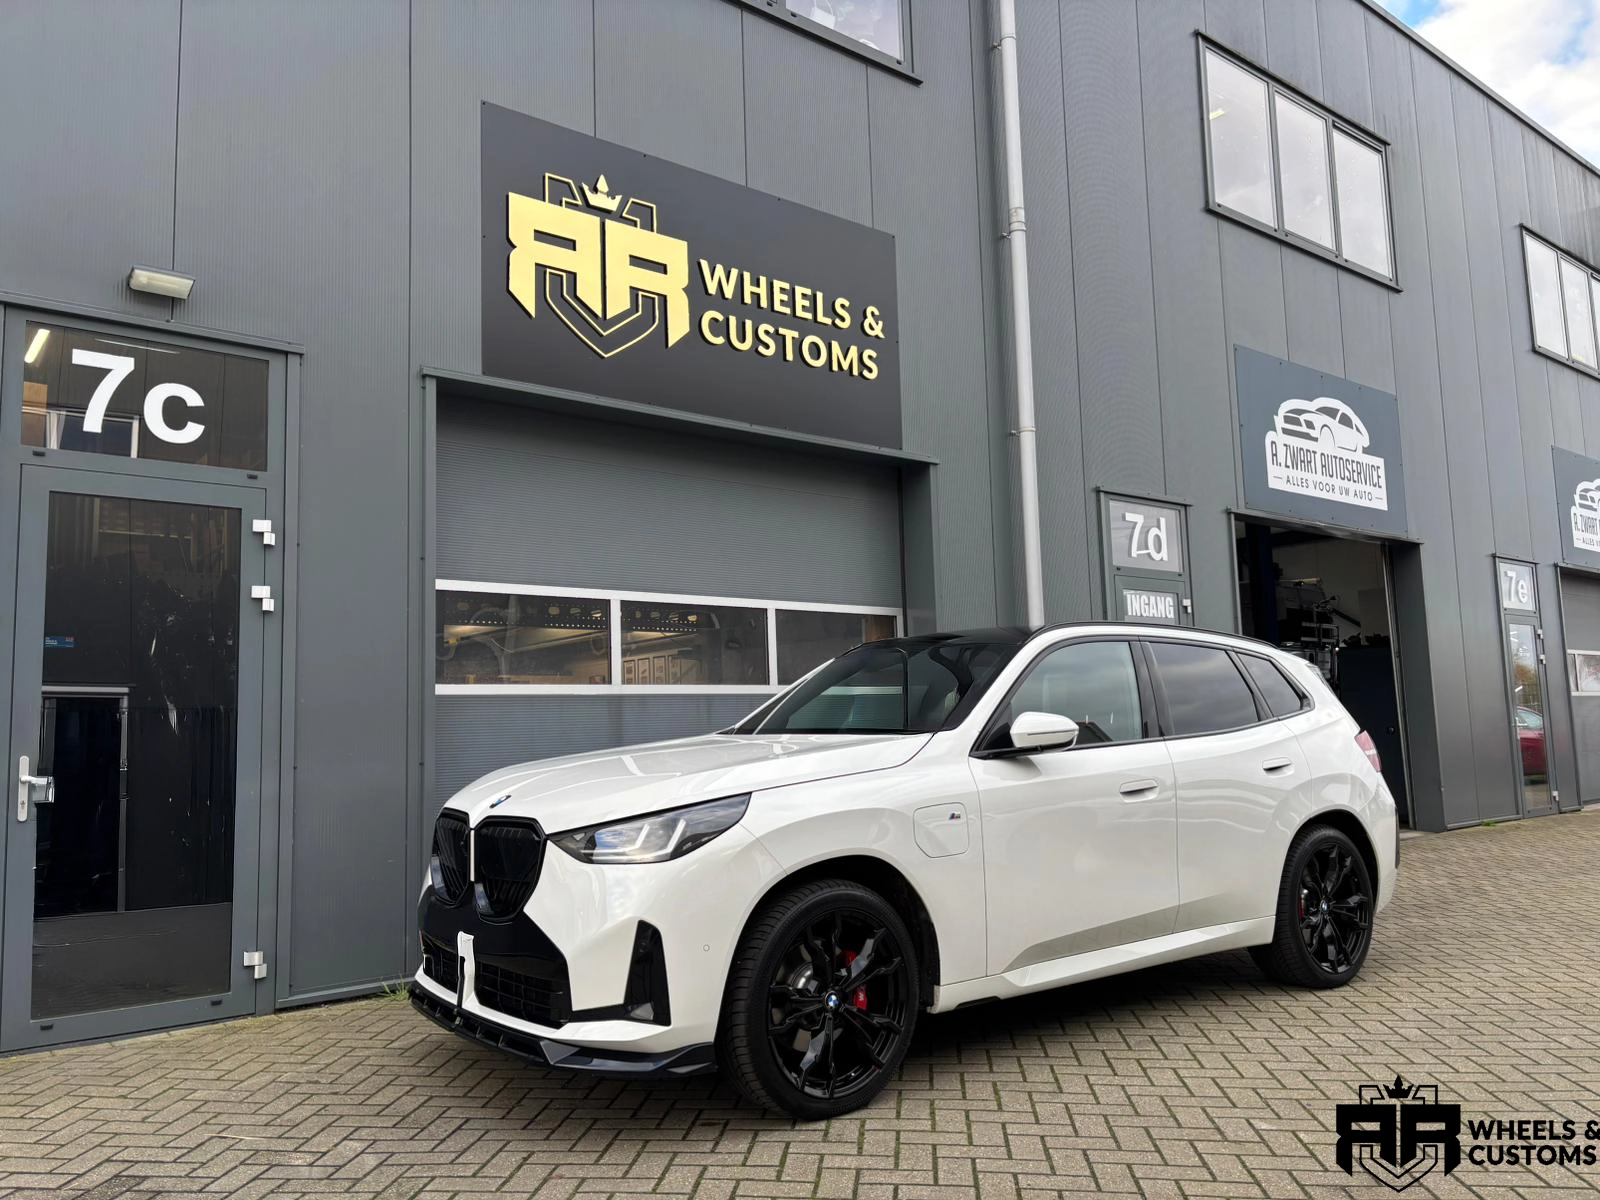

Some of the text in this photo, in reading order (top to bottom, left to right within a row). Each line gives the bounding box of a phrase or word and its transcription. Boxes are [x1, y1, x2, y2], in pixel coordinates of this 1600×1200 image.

[699, 258, 886, 339] WHEELS &
[700, 310, 879, 380] CUSTOMS
[1270, 440, 1383, 489] A. ZWART AUTOSERVICE
[1286, 475, 1373, 502] ALLES VOOR UW AUTO
[1126, 593, 1174, 619] INGANG
[1505, 570, 1529, 604] 7e
